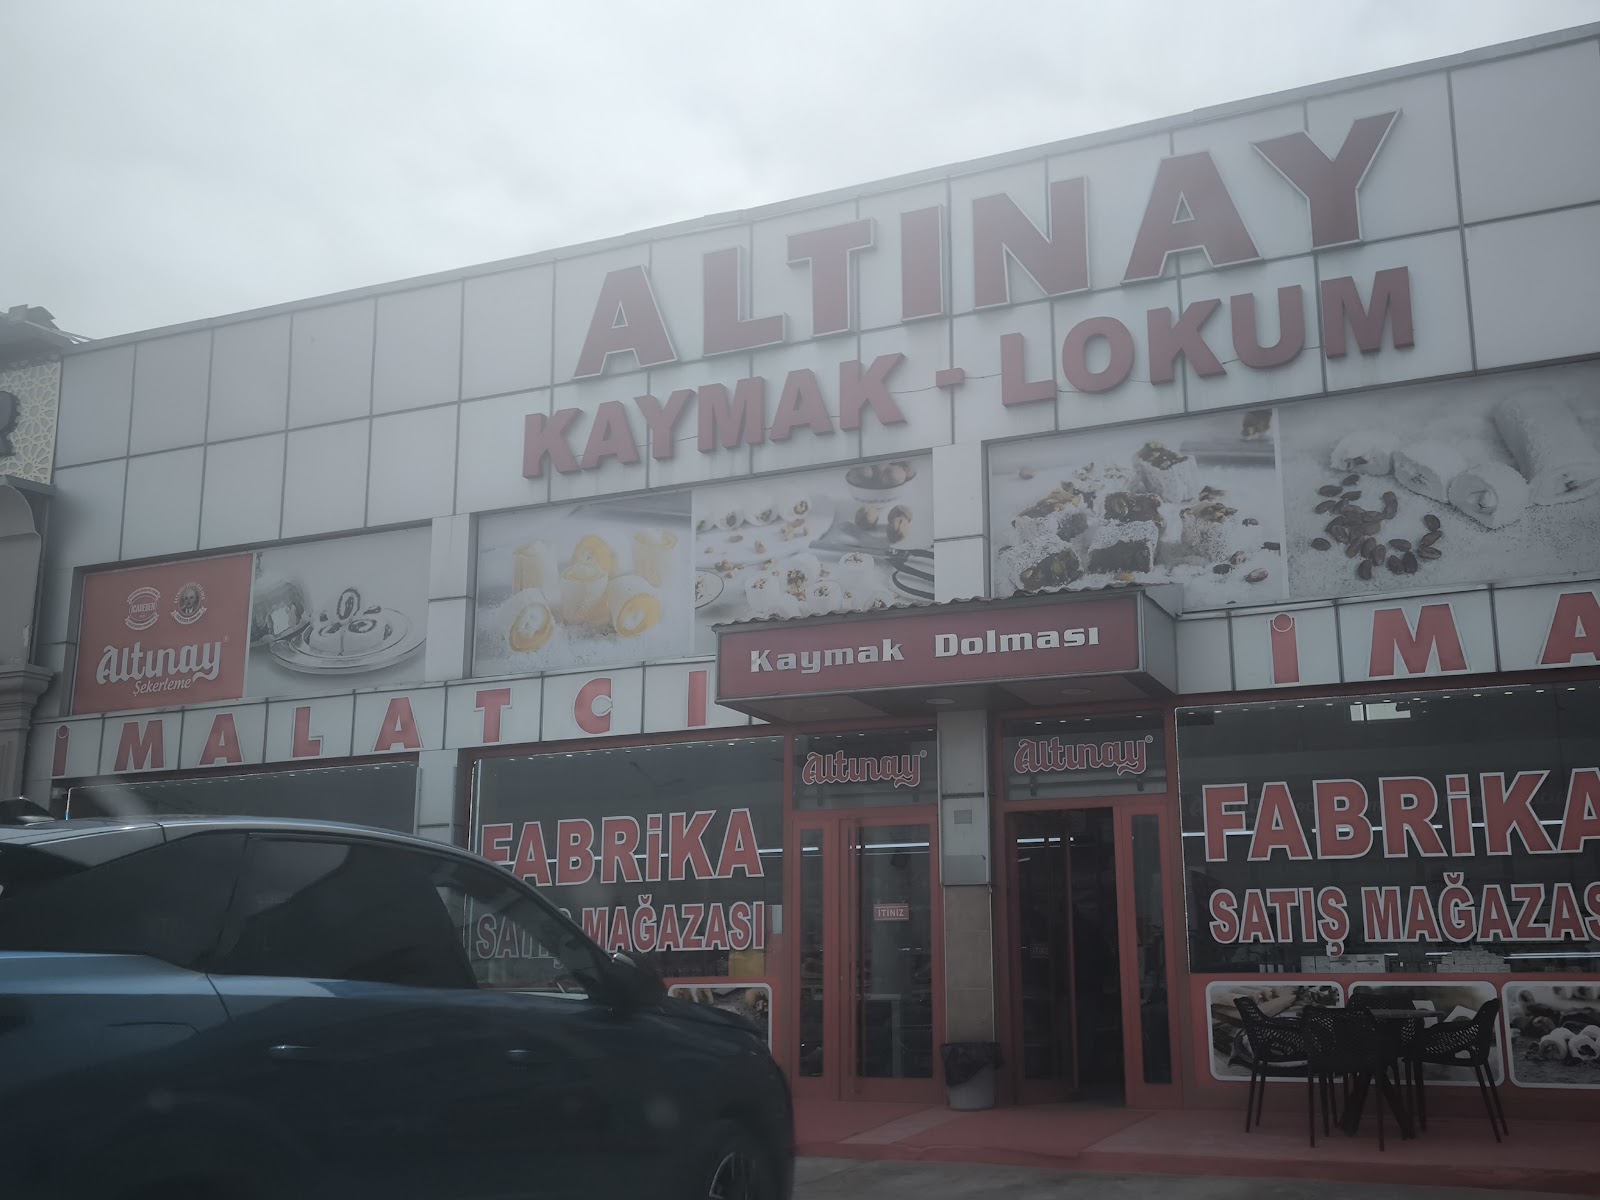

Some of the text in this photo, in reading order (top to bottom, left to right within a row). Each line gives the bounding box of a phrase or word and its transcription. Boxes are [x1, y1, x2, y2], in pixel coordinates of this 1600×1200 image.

[571, 107, 1402, 379] ALTINAY
[522, 352, 907, 480] KAYMAK
[1000, 265, 1415, 407] LOKUM
[95, 641, 222, 685] Altınay
[750, 626, 1100, 674] Kaymak Dolması
[132, 677, 192, 697] Şekerleme
[801, 749, 922, 789] Altınay
[1014, 736, 1148, 776] Altınay
[581, 893, 765, 954] MAĞAZASI
[1209, 887, 1350, 957] SATIŞ
